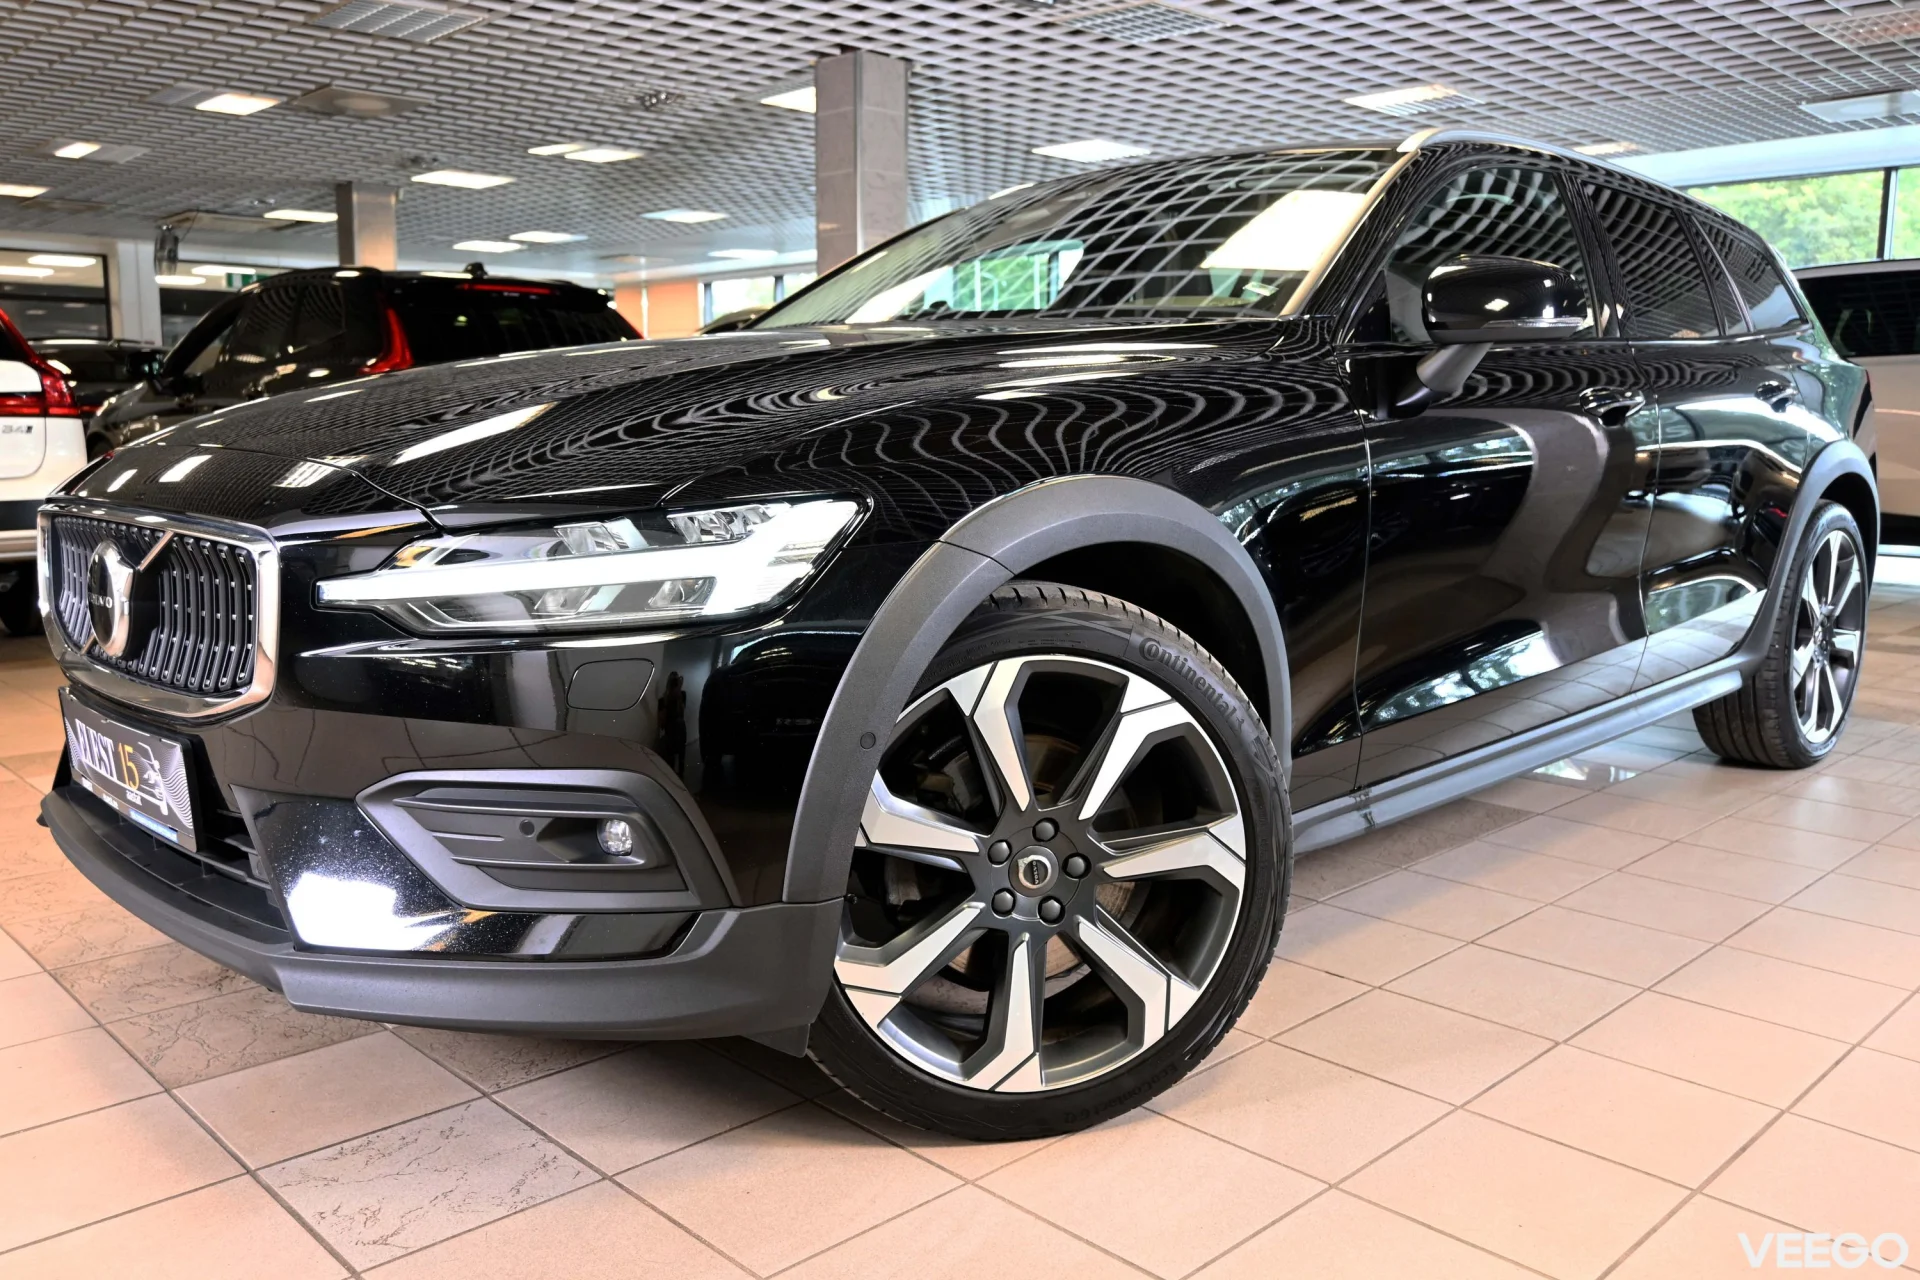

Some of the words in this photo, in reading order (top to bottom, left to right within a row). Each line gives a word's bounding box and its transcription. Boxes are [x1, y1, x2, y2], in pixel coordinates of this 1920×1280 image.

[1139, 637, 1238, 719] Continental
[118, 743, 140, 790] 15
[1032, 861, 1040, 885] VOLVO
